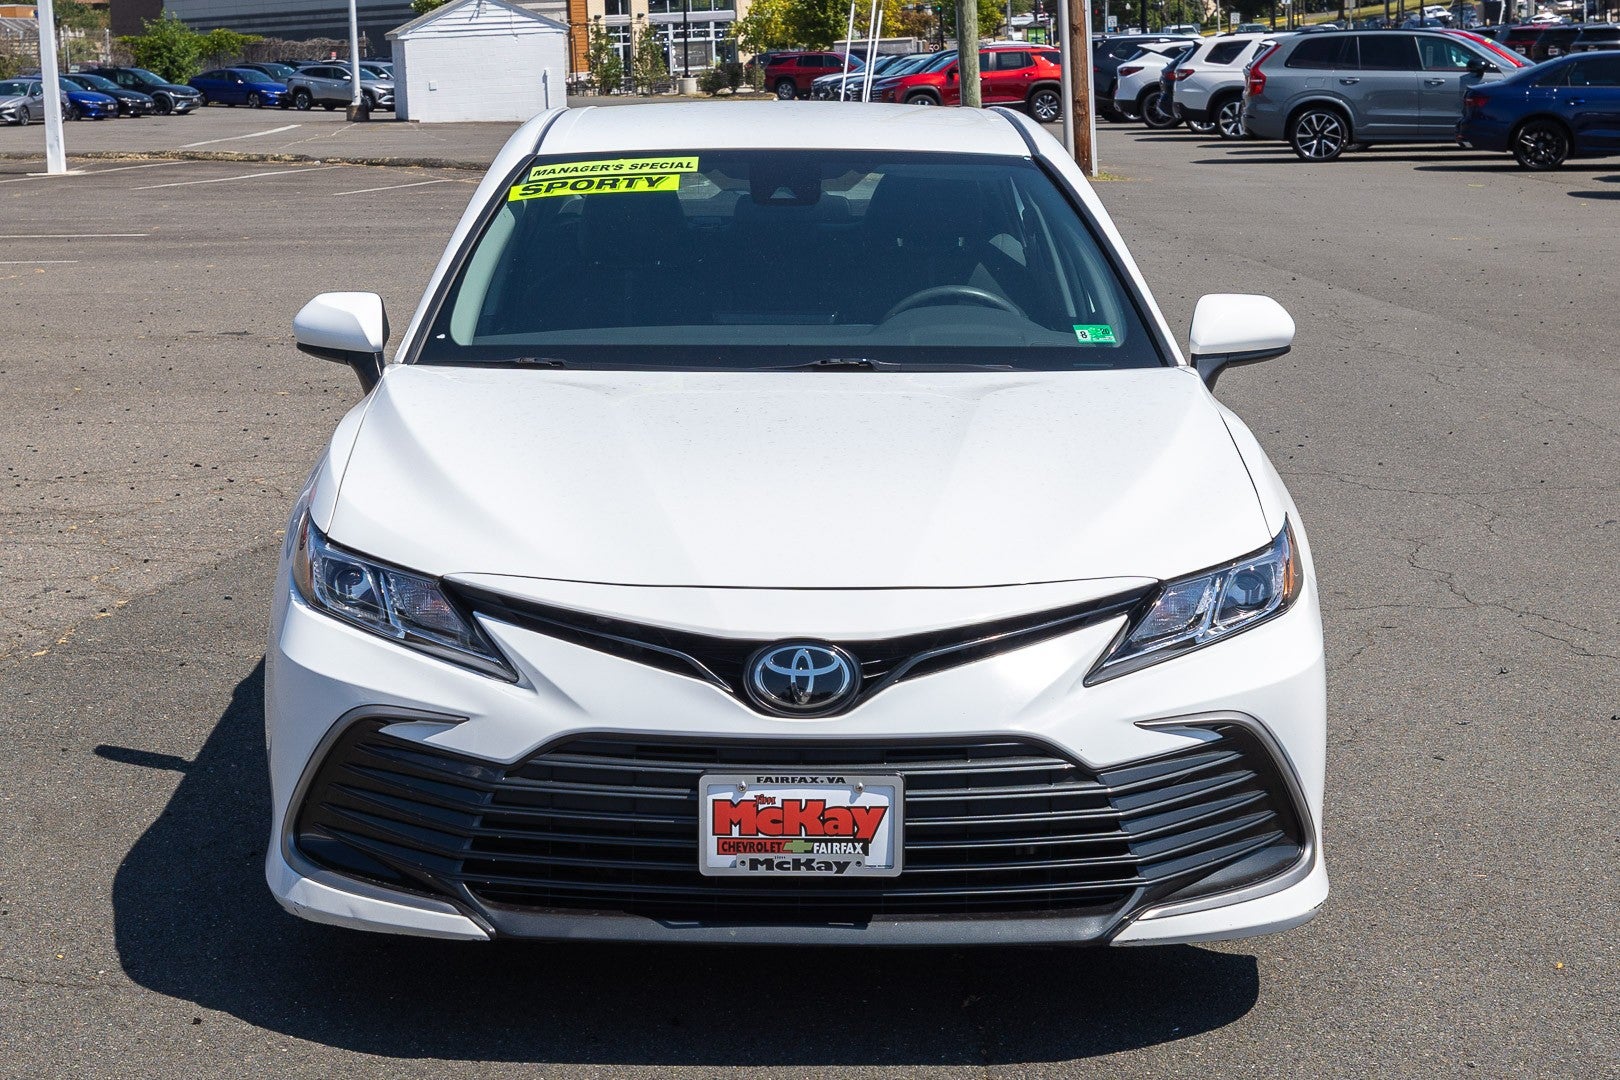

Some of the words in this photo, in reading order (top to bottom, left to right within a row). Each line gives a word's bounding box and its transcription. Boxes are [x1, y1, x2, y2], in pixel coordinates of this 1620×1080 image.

[533, 164, 624, 177] MANAGER'S
[628, 161, 694, 170] SPECIAL
[519, 176, 669, 196] SPORTY
[712, 799, 889, 844] McKay
[721, 841, 782, 853] CHEVROLET
[813, 842, 864, 854] FAIRFAX
[749, 858, 851, 875] McKay
